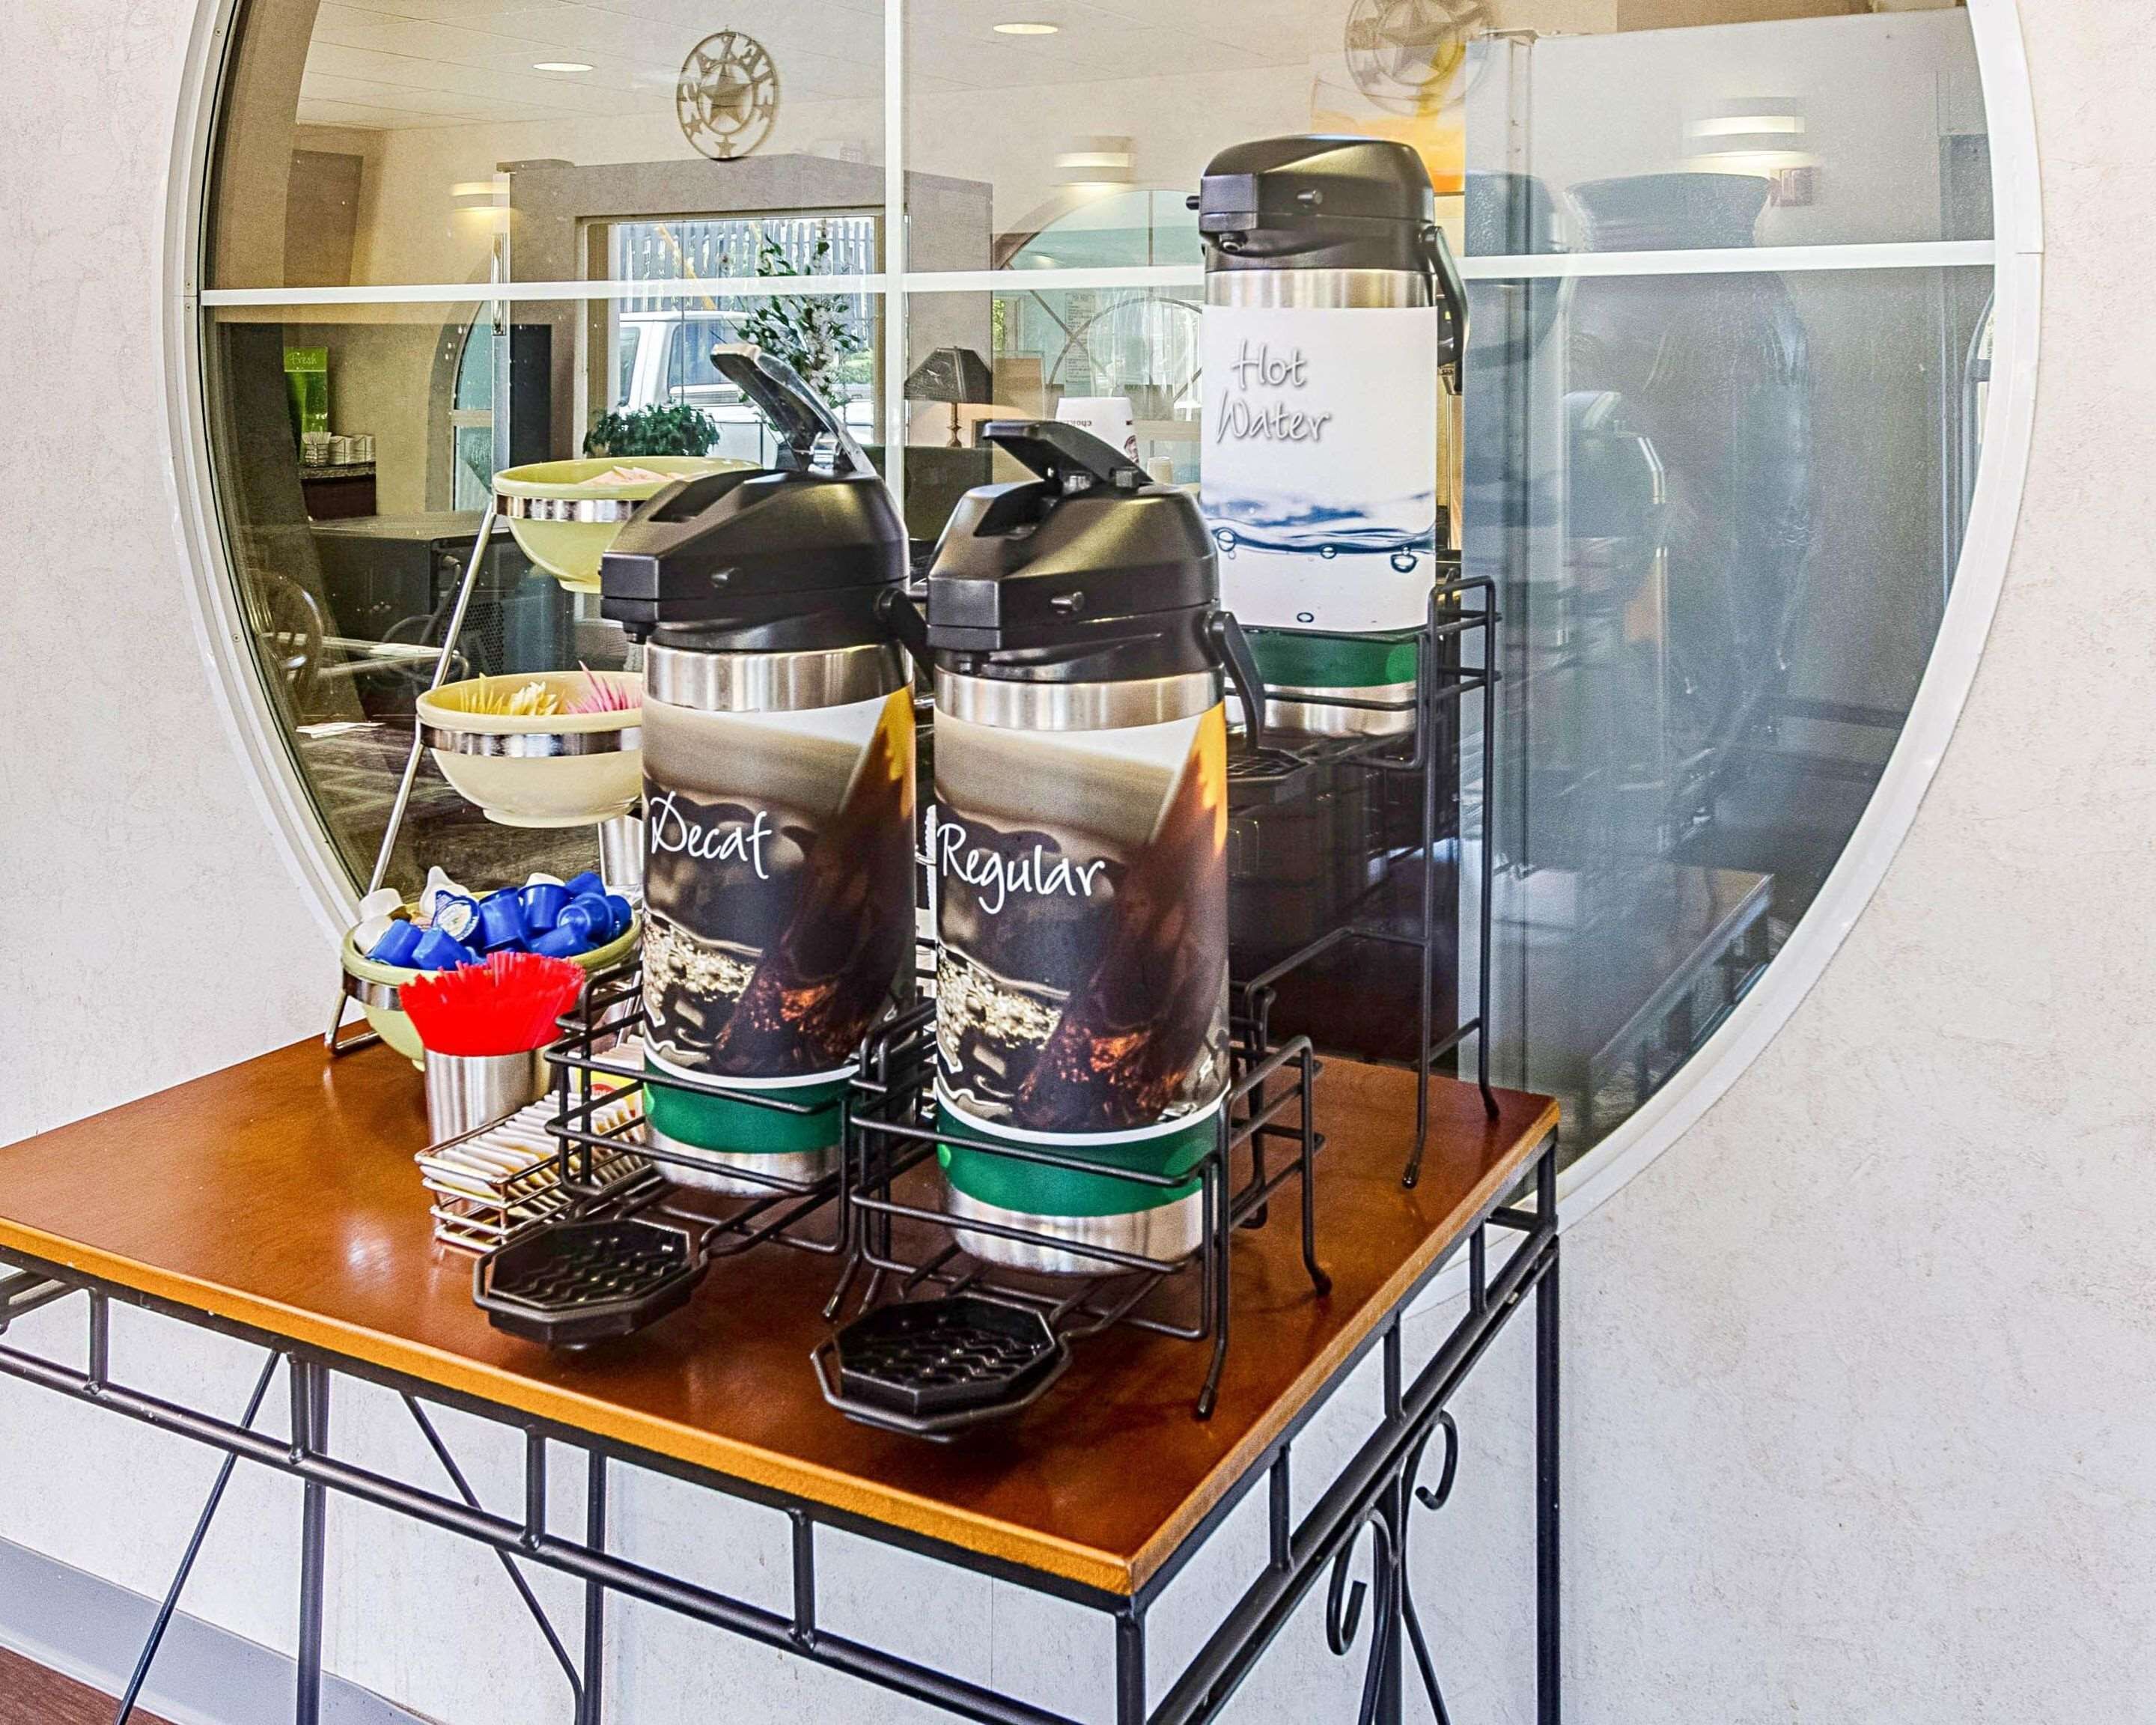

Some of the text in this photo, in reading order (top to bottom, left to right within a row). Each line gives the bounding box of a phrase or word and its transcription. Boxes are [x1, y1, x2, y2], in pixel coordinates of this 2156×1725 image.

[1231, 339, 1309, 390] Hot
[1216, 389, 1333, 444] Water
[651, 791, 773, 880] Decaf
[937, 823, 1106, 914] Regular
